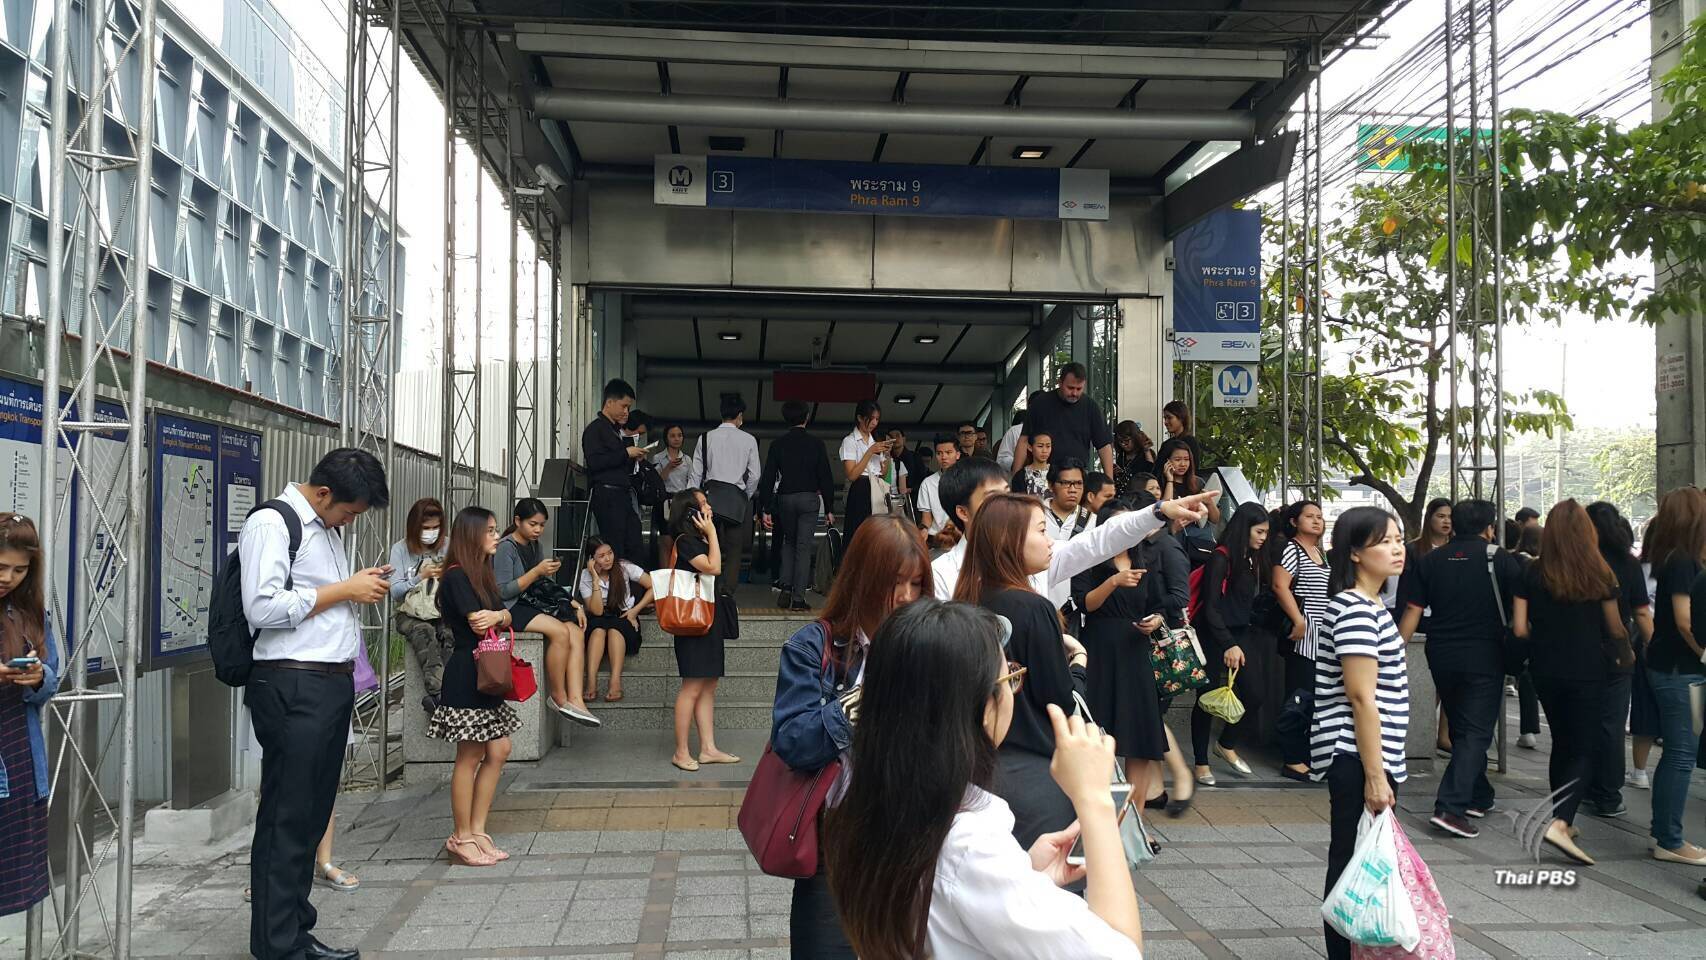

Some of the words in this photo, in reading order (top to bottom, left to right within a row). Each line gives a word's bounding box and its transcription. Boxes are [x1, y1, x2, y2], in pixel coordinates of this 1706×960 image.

[718, 174, 728, 189] 3
[850, 179, 907, 192] พระราม
[912, 179, 921, 193] 9
[850, 193, 878, 206] Phra
[881, 195, 908, 207] Ram
[912, 195, 921, 208] 9
[1201, 265, 1245, 276] พระราม
[1249, 265, 1257, 276] 9
[1203, 278, 1224, 288] Phra
[1226, 278, 1247, 288] Ram
[1249, 279, 1257, 288] 9
[1241, 305, 1250, 318] 3
[1221, 340, 1256, 349] BEM
[1222, 370, 1248, 393] M
[19, 413, 44, 428] Transpo
